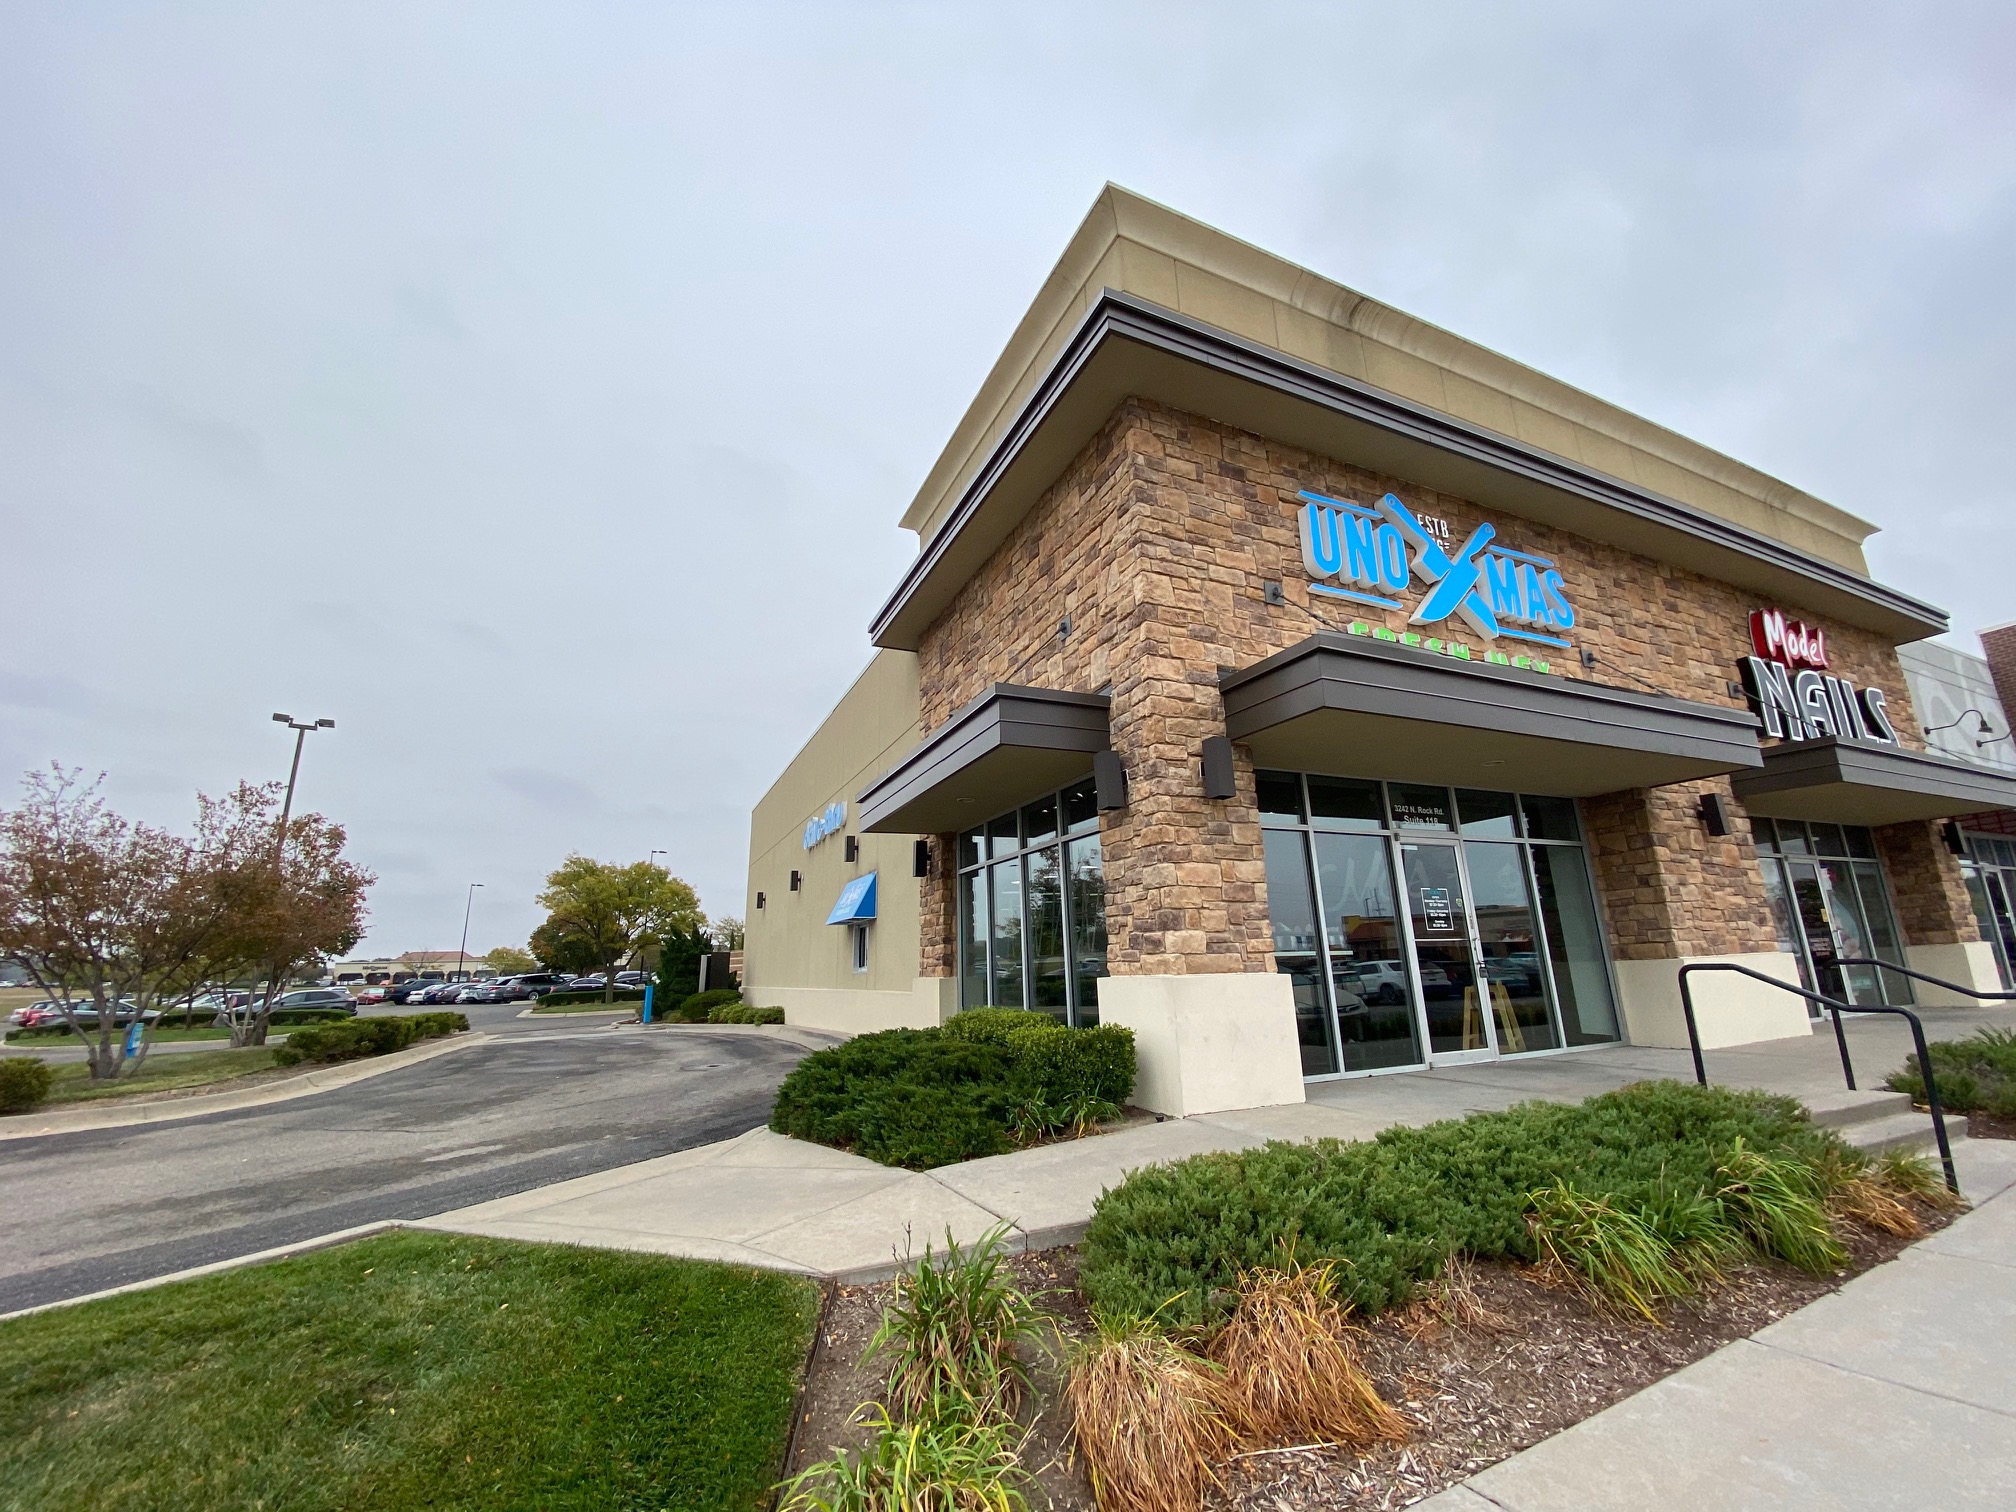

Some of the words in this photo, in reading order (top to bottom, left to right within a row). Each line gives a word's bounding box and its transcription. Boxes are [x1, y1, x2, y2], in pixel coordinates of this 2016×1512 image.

[1298, 502, 1410, 594] UNO
[1474, 553, 1574, 632] MAS
[1755, 607, 1830, 668] Model
[1747, 655, 1901, 748] NAILS
[1394, 804, 1409, 813] 3242
[1409, 806, 1418, 814] N.
[1418, 806, 1434, 815] Rock
[1434, 808, 1445, 816] Rd.
[1403, 815, 1424, 825] Suite
